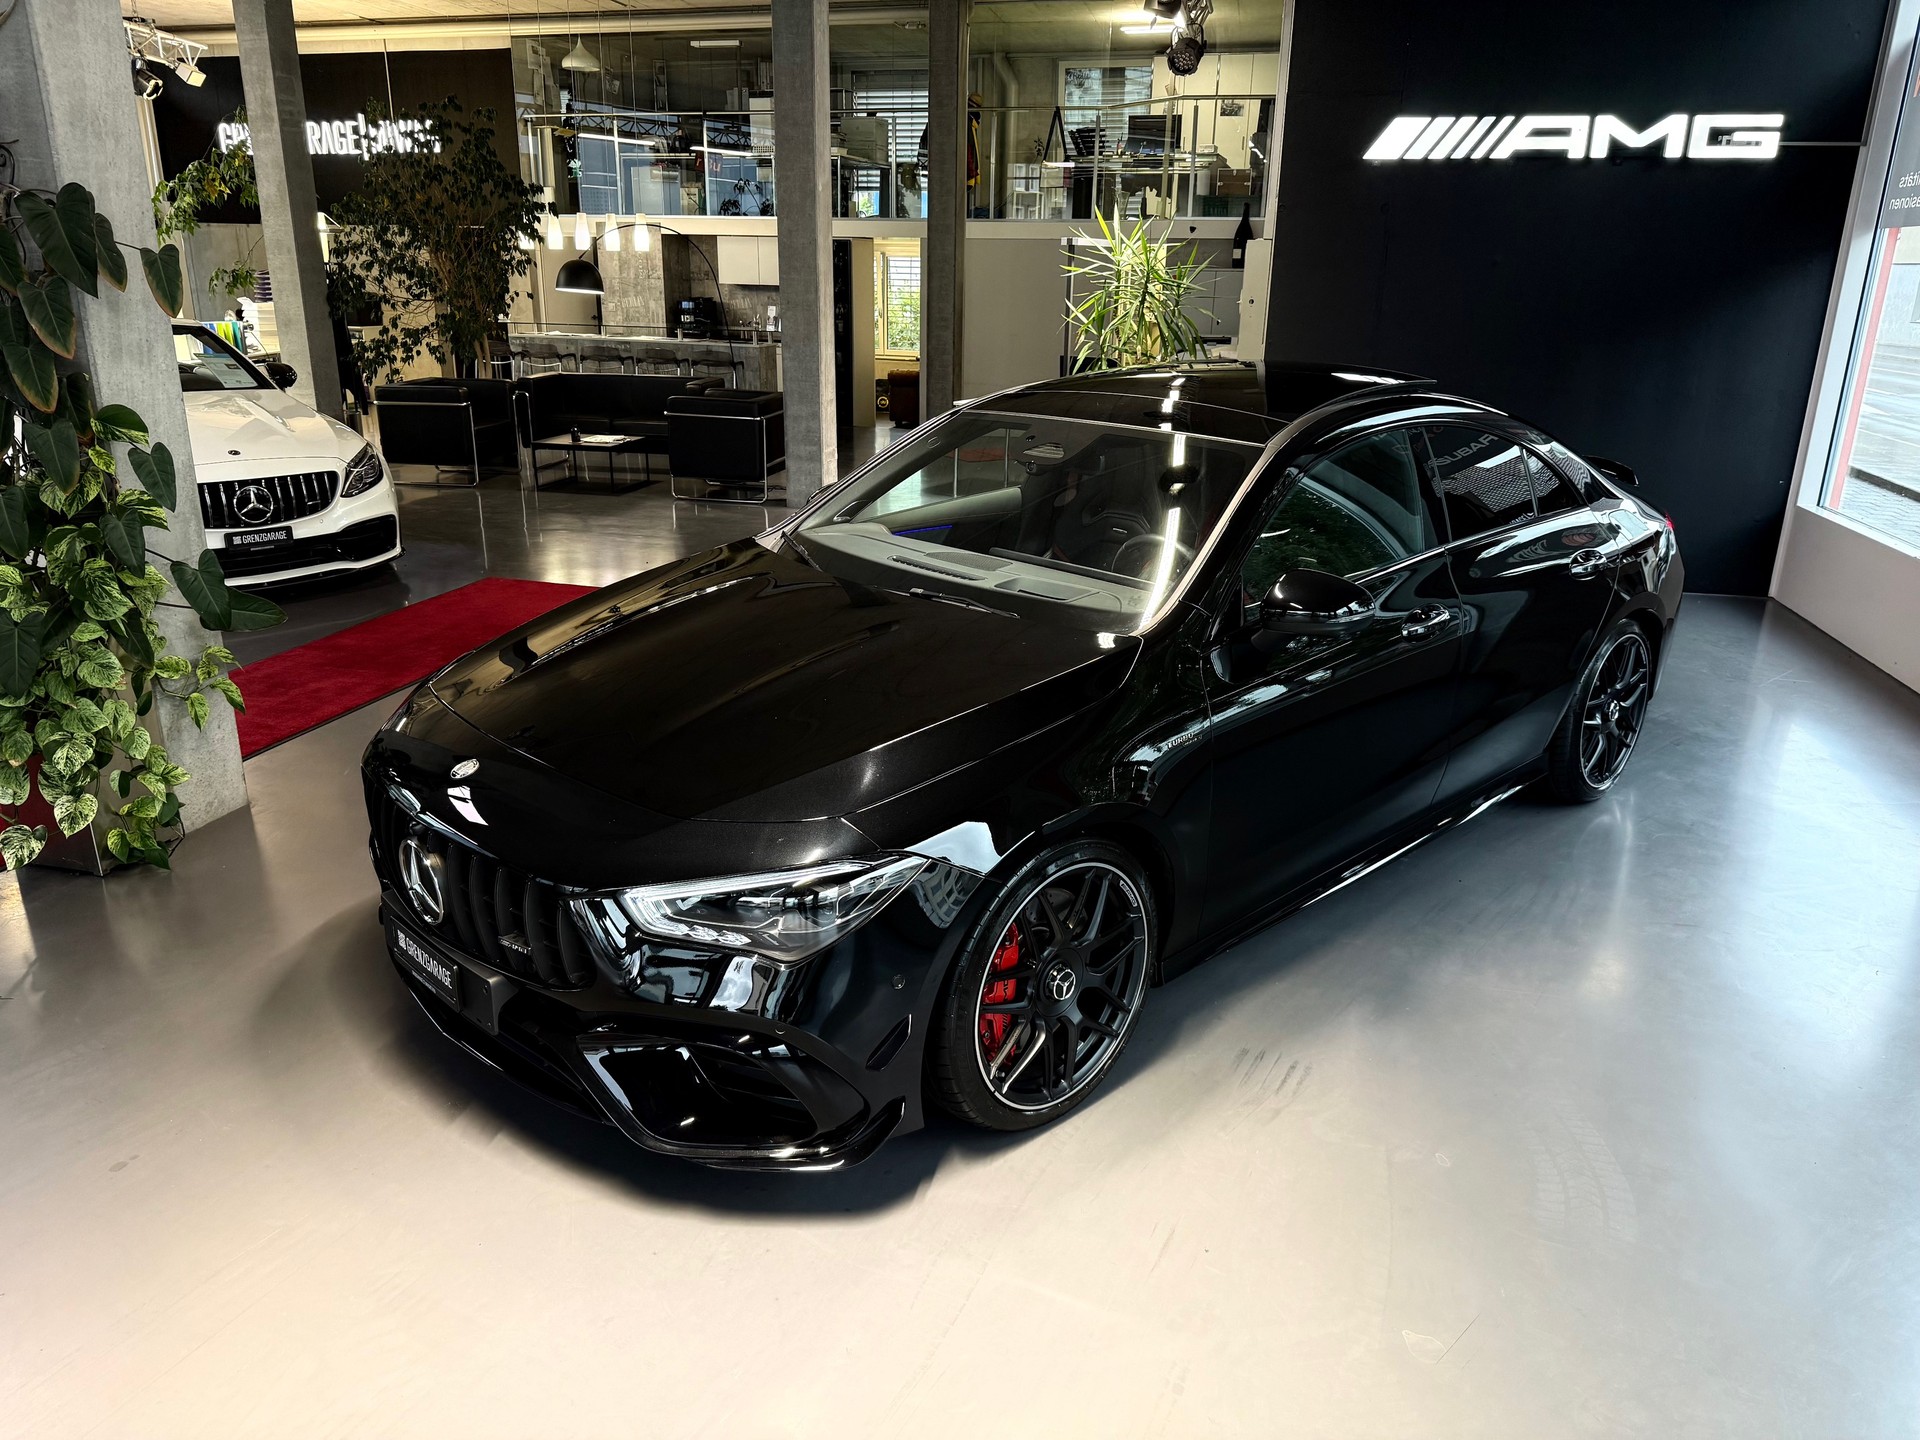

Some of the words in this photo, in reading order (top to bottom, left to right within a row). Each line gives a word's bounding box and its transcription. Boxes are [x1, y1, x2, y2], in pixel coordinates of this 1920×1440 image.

[1488, 113, 1784, 159] AMG
[242, 530, 287, 543] GRENZGARAGE
[1168, 732, 1194, 749] TURBO
[406, 937, 453, 989] GRENZGARAGE
